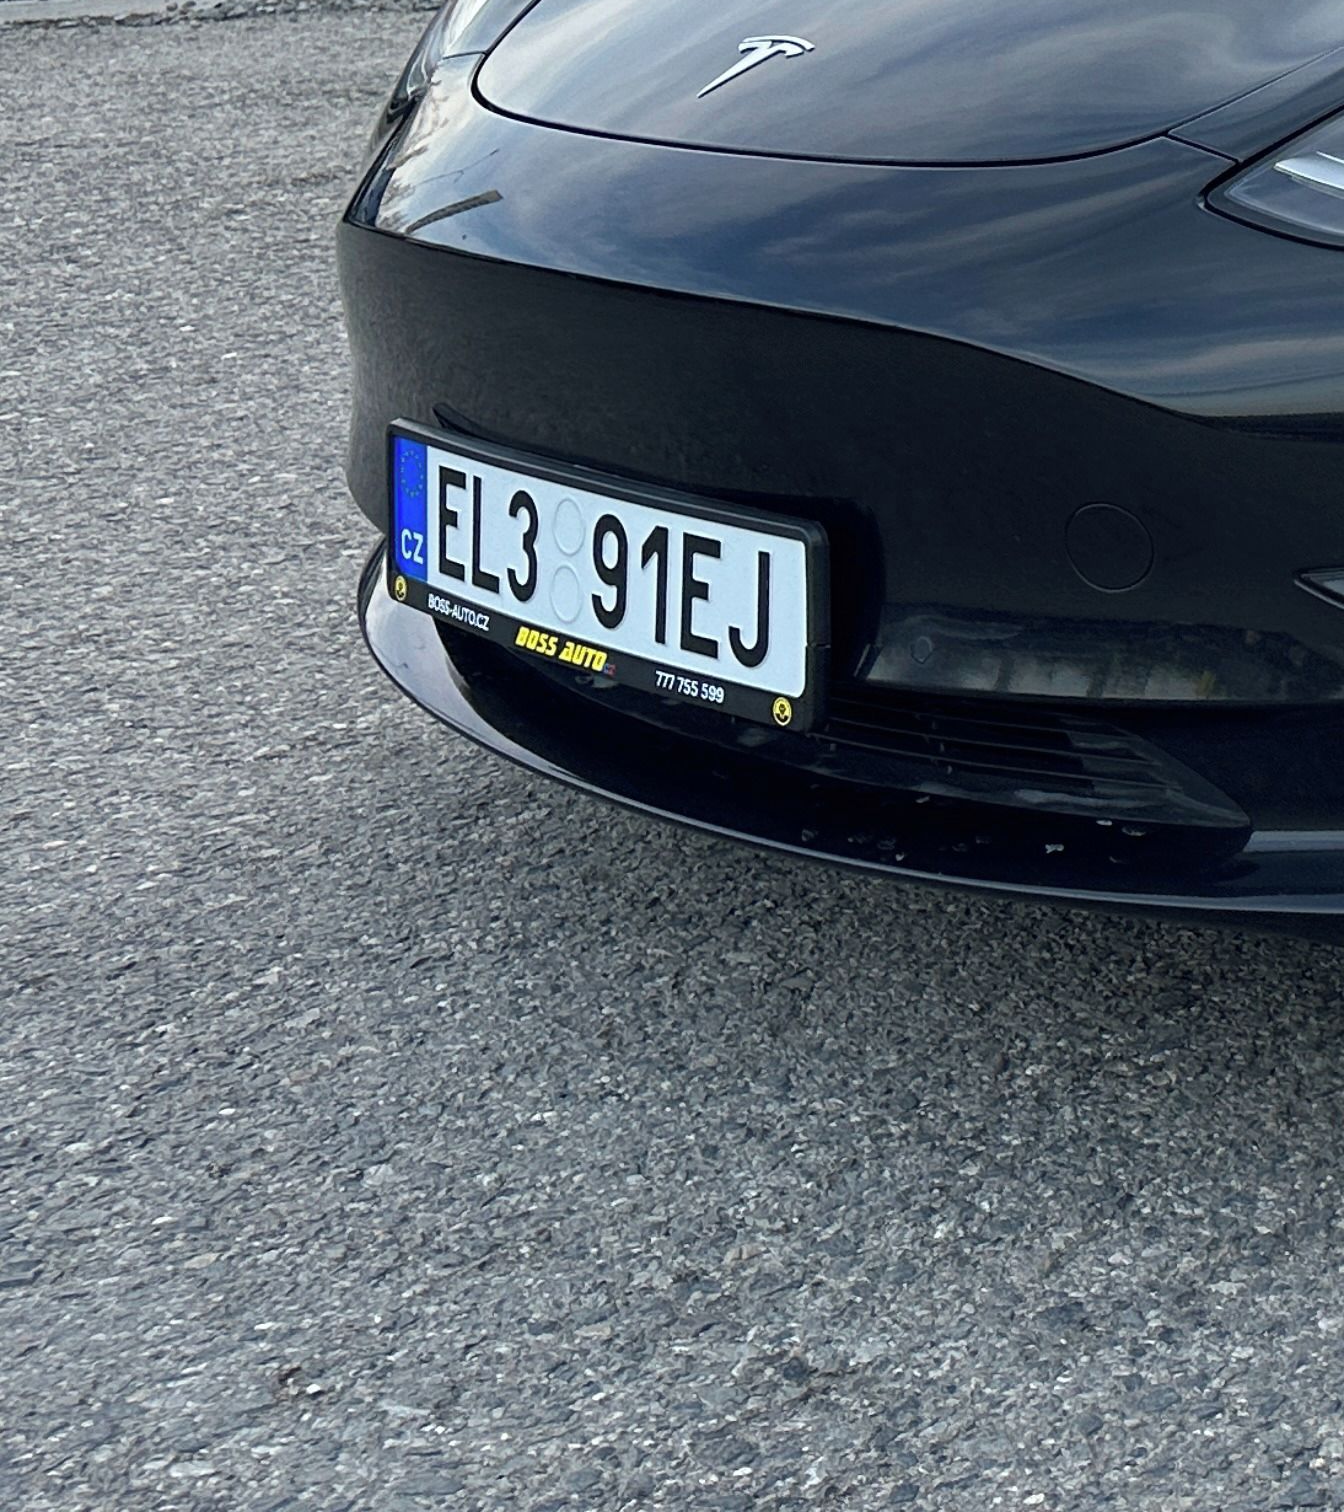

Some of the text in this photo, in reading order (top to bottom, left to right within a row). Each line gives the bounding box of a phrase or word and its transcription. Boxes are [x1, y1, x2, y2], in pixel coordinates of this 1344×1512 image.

[401, 464, 770, 668] CZ EL3 91EJ
[428, 593, 490, 631] BOSS-AUTO.CZ
[515, 625, 558, 656] BOSS
[558, 641, 608, 672] AUTO
[655, 670, 725, 703] 777 755 599
